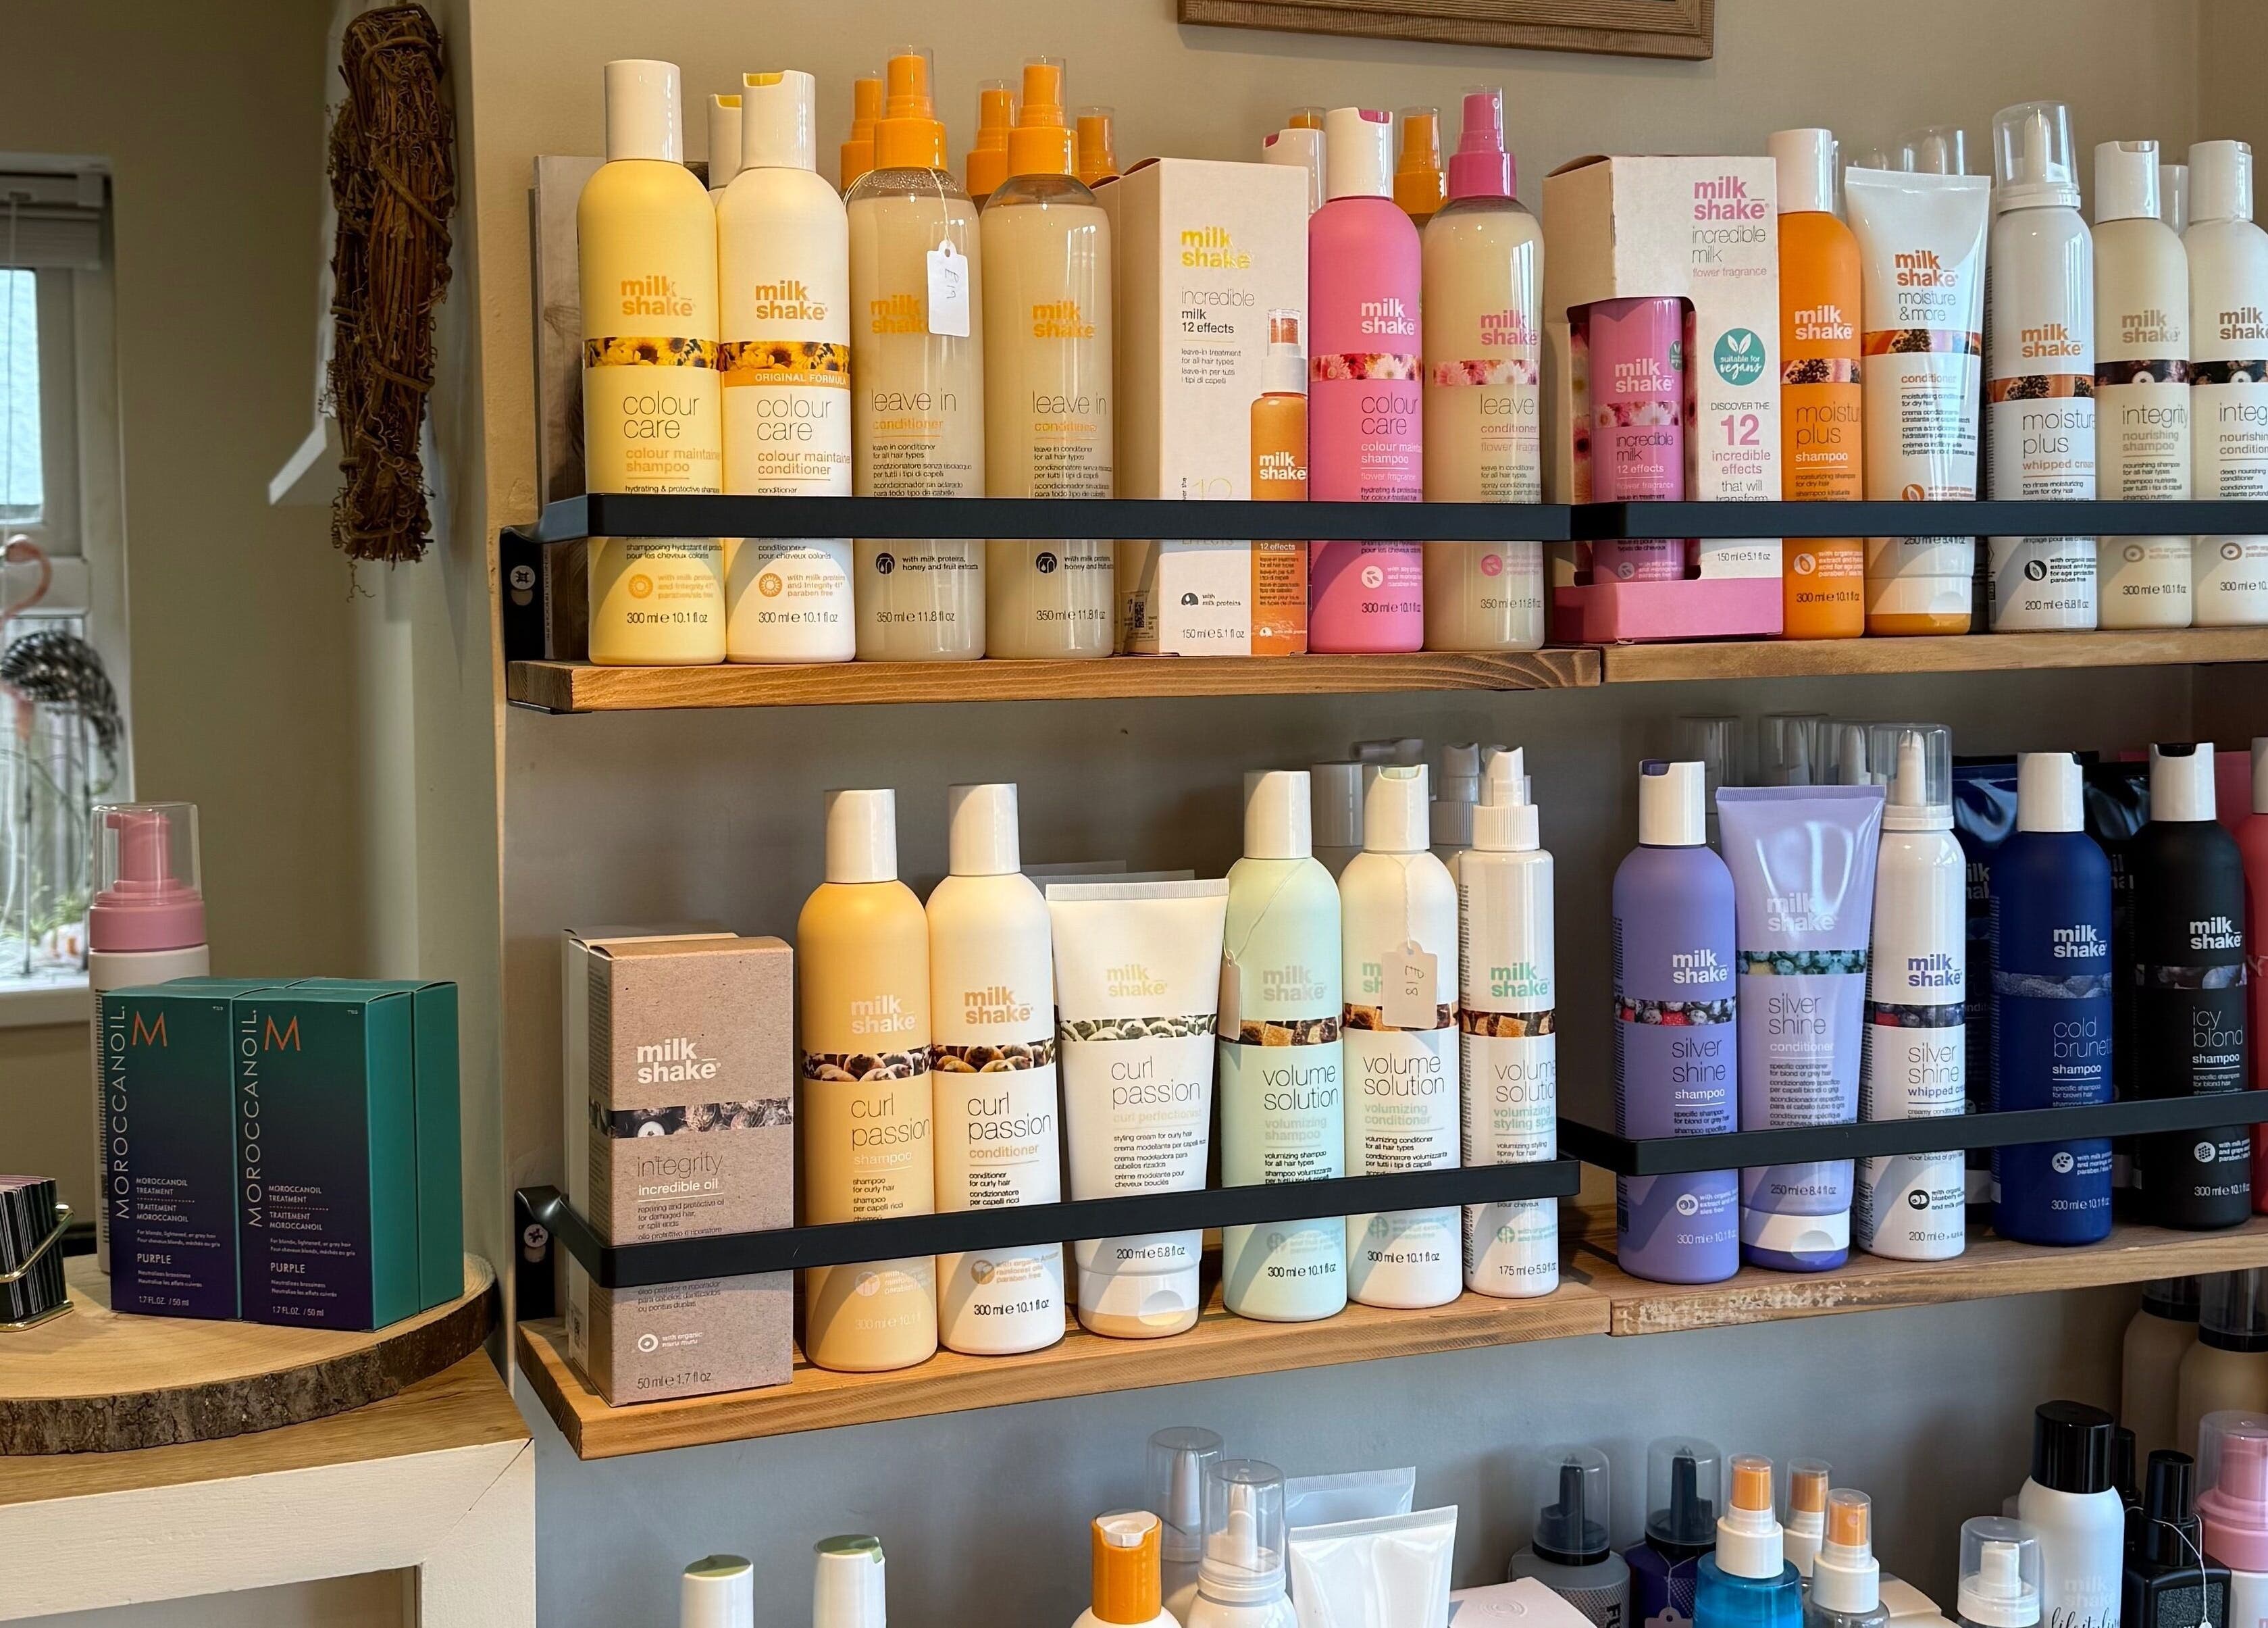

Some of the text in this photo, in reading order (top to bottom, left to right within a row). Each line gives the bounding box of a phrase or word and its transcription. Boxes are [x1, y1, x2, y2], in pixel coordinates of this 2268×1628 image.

[1694, 176, 1747, 199] milk
[1182, 226, 1233, 248] milk
[1693, 226, 1766, 244] incredible
[1693, 245, 1722, 263] milk
[1895, 249, 1940, 270] milk
[1723, 268, 1767, 278] fragrance
[620, 276, 676, 297] milk
[755, 280, 809, 301] milk
[1182, 286, 1255, 307] incredible
[1899, 290, 1956, 305] moisture
[1182, 309, 1206, 320] milk
[1361, 298, 1405, 317] milk
[1795, 305, 1841, 324] milk
[1899, 307, 1946, 322] & more
[1182, 322, 1234, 334] 12 effects
[2021, 324, 2068, 342] milk
[1616, 358, 1660, 377] milk
[1719, 363, 1761, 380] vegans
[755, 373, 847, 386] ORIGINAL FORMULA
[623, 390, 700, 416] colour
[756, 394, 832, 418] colour
[871, 388, 956, 411] leave in
[1033, 389, 1108, 414] leave in
[1362, 392, 1418, 415] colour
[1480, 393, 1535, 415] leave
[1711, 403, 1753, 411] DISCOVER
[623, 419, 680, 438] care
[756, 422, 813, 440] care
[1362, 417, 1407, 435] care
[1720, 415, 1759, 446] 12
[1797, 424, 1841, 450] plus
[2122, 431, 2179, 441] nourishing
[626, 447, 669, 459] colour
[1362, 442, 1395, 452] colour
[2023, 434, 2069, 458] plus
[2123, 441, 2175, 451] shampoo
[758, 451, 800, 463] colour
[1259, 452, 1295, 466] milk
[1361, 454, 1409, 464] shampoo
[1712, 450, 1770, 461] incredible
[1795, 451, 1848, 463] shampoo
[626, 461, 690, 474] shampoo
[758, 464, 831, 475] conditioner
[1617, 464, 1664, 474] 12 effects
[1722, 463, 1762, 474] effects
[2023, 460, 2071, 471] whipped
[1722, 481, 1763, 492] that will
[2054, 925, 2097, 942] milk
[2190, 917, 2232, 934] milk
[1672, 949, 1718, 968] milk
[1908, 954, 1952, 971] milk
[1491, 961, 1537, 981] milk
[851, 995, 902, 1016] milk
[964, 987, 1015, 1007] milk
[1768, 993, 1822, 1014] silver
[1769, 1014, 1826, 1036] shine
[2054, 1017, 2096, 1038] cold
[2194, 1007, 2221, 1030] icy
[132, 1011, 167, 1047] M
[263, 1015, 301, 1052] M
[2194, 1027, 2243, 1048] blond
[638, 1038, 697, 1063] milk
[1672, 1038, 1722, 1058] silver
[1908, 1042, 1957, 1063] silver
[1364, 1052, 1441, 1075] volume
[2192, 1053, 2240, 1065] shampoo
[1112, 1056, 1153, 1081] curl
[1263, 1064, 1336, 1087] volume
[1672, 1061, 1726, 1082] shine
[1908, 1063, 1959, 1084] shine
[2053, 1065, 2101, 1075] shampoo
[1113, 1079, 1200, 1110] passion
[1364, 1075, 1445, 1096] solution
[1675, 1089, 1725, 1100] shampoo
[1908, 1087, 1953, 1098] whipped
[851, 1092, 894, 1119] curl
[967, 1092, 1010, 1116] curl
[1264, 1087, 1339, 1111] solution
[1364, 1102, 1428, 1116] volumizing
[969, 1113, 1051, 1144] passion
[1364, 1114, 1431, 1127] conditioner
[1494, 1117, 1532, 1131] styling
[852, 1117, 930, 1151] passion
[854, 1151, 912, 1165] shampoo
[969, 1144, 1039, 1159] conditioner
[638, 1151, 724, 1179] integrity
[136, 1178, 188, 1186] MOROCCANOIL
[269, 1186, 322, 1194] MOROCCANOIL
[639, 1178, 718, 1196] incredible oil
[1771, 1184, 1788, 1195] 250
[1809, 1185, 1822, 1195] 8.4
[269, 1195, 307, 1203] TREATMENT
[136, 1214, 189, 1223] MOROCCANOIL
[270, 1212, 310, 1220] TRAITEMENT
[270, 1222, 323, 1231] MOROCCANOIL
[137, 1254, 172, 1264] PURPLE
[1116, 1248, 1133, 1259] 200
[1135, 1248, 1145, 1258] ml
[1158, 1247, 1170, 1257] 6.8
[270, 1263, 305, 1273] PURPLE
[974, 1304, 991, 1316] 300
[993, 1306, 1003, 1315] ml
[1016, 1300, 1034, 1313] 10.1
